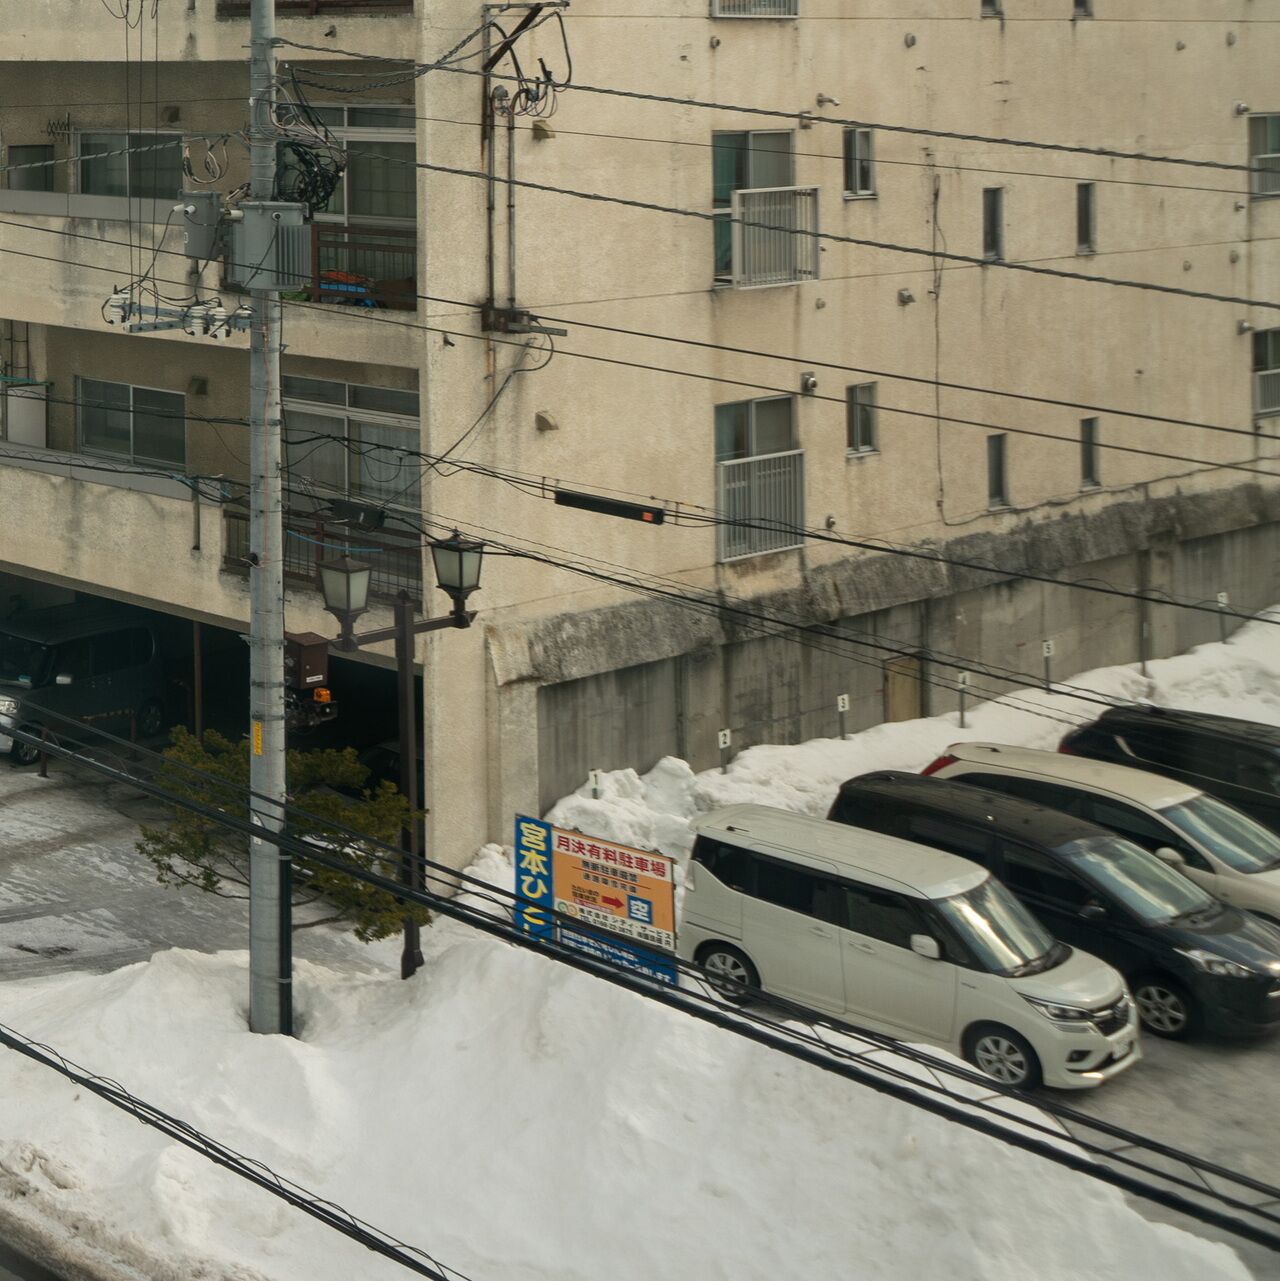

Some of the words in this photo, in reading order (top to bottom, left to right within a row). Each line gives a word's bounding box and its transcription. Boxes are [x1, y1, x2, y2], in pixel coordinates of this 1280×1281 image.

[519, 822, 549, 944] 宮本ひと
[556, 835, 666, 877] 月決有料駐車場
